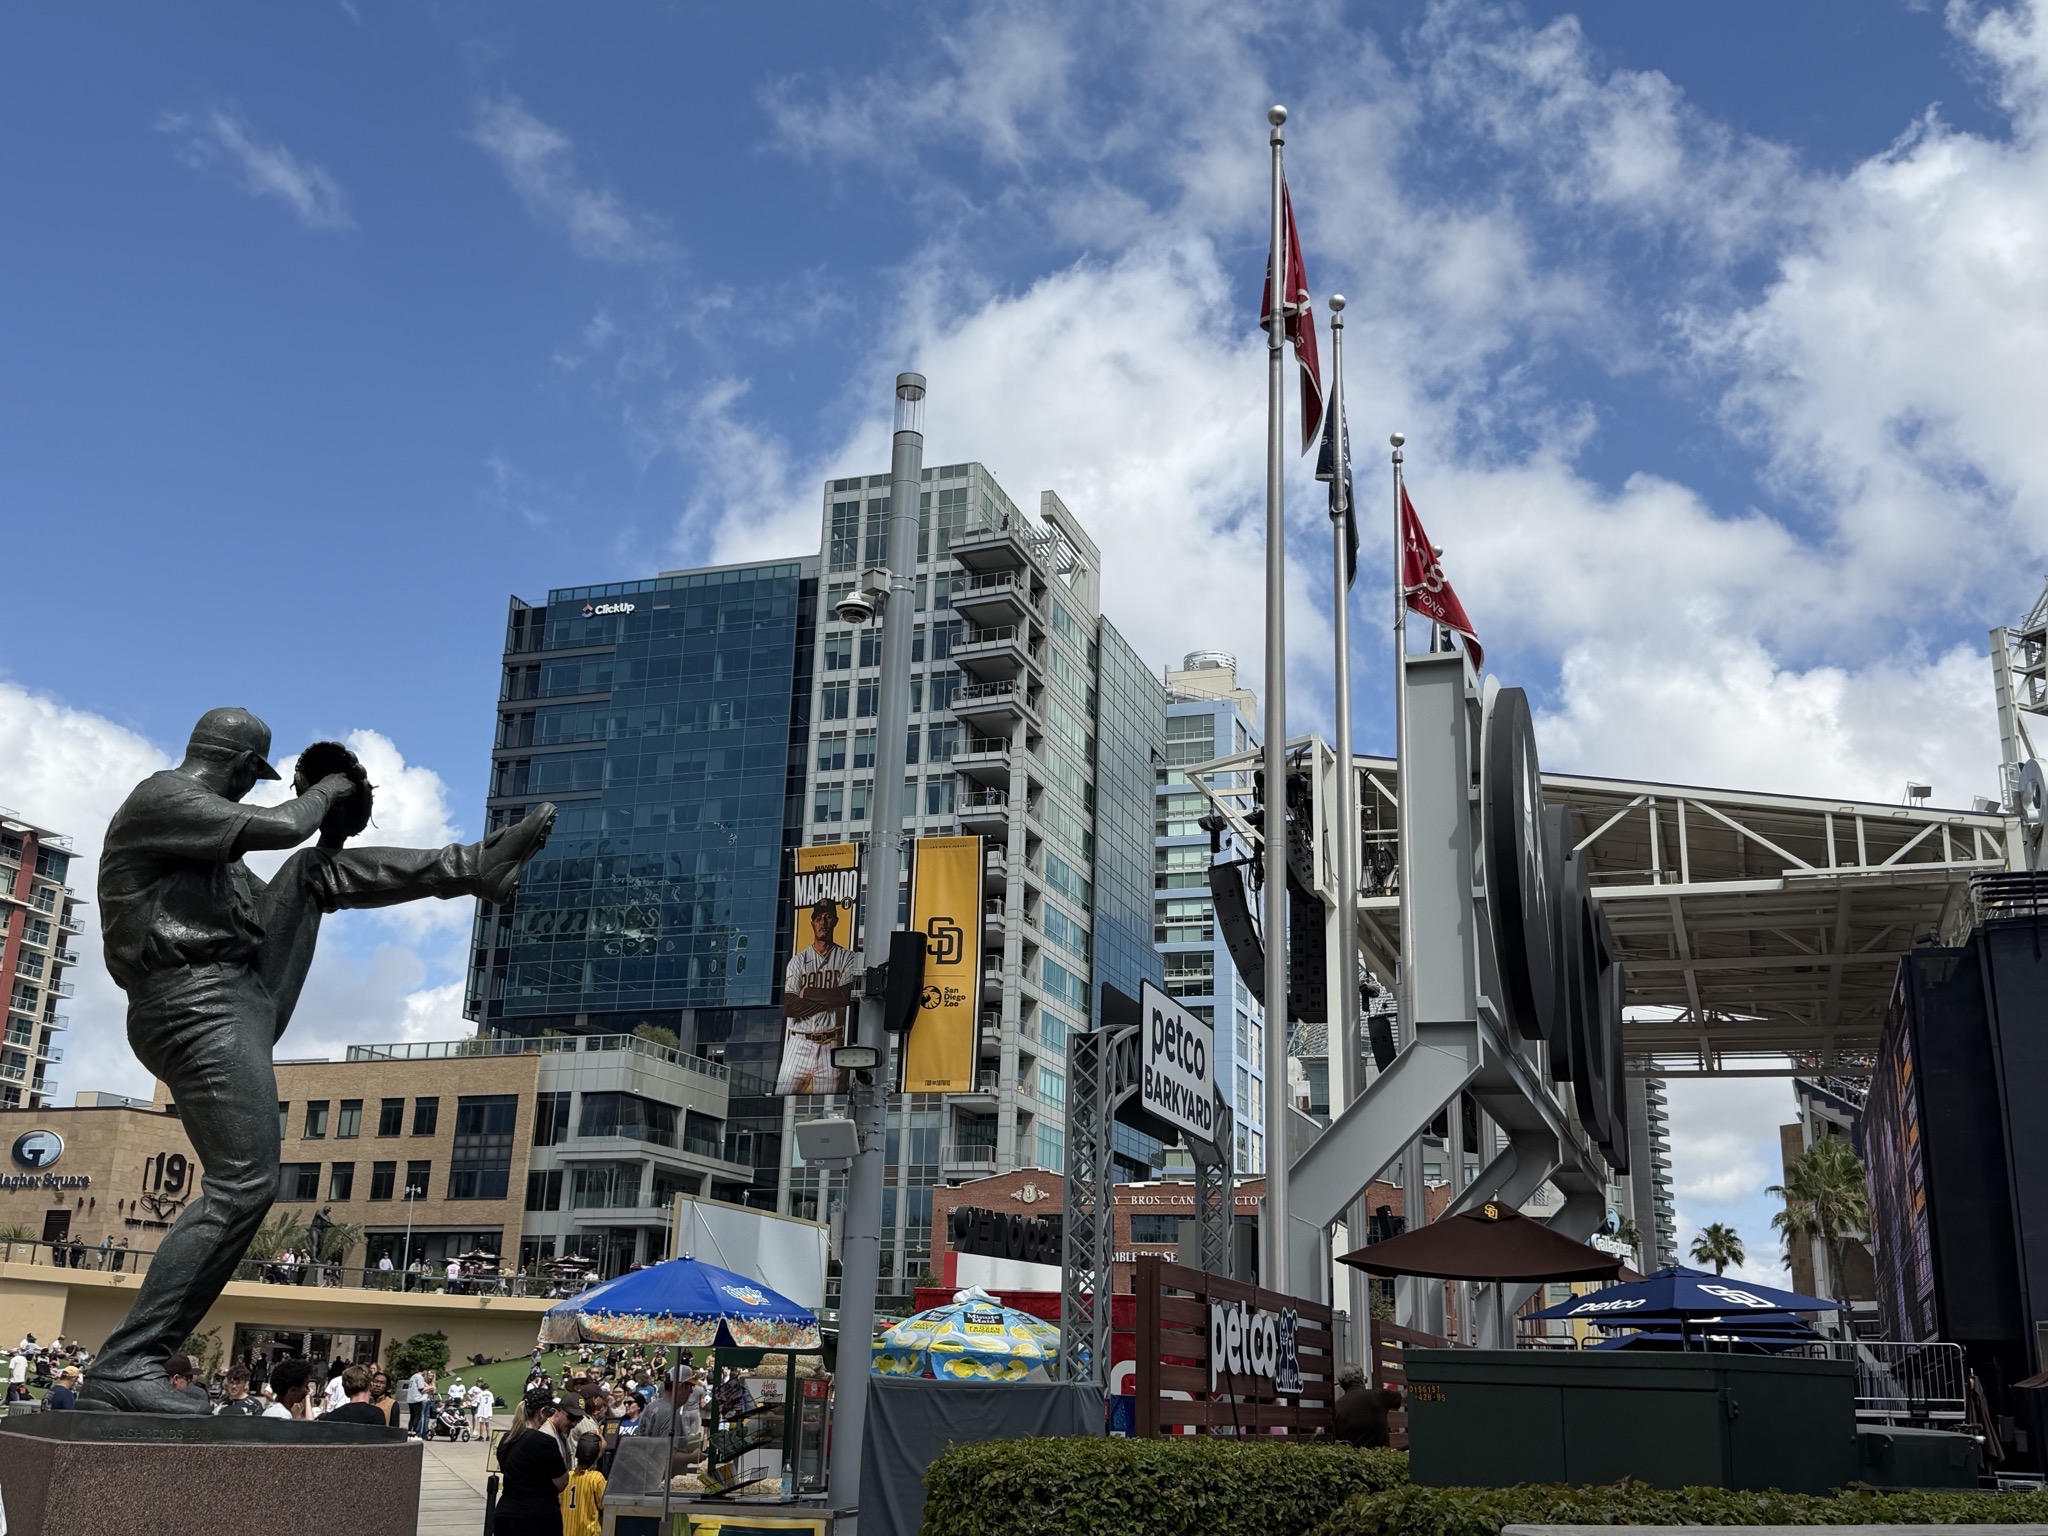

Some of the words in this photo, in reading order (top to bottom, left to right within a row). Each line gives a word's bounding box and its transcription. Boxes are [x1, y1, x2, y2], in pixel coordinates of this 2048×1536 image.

[594, 602, 635, 615] ClickUp
[795, 870, 858, 907] MACHADO
[927, 916, 963, 965] SD
[944, 993, 966, 1002] Diego
[1152, 1007, 1205, 1081] petco
[1144, 1063, 1212, 1131] BARKYARD
[0, 1172, 42, 1190] lagher
[43, 1172, 91, 1190] Square
[153, 1152, 187, 1193] 19
[1131, 1195, 1163, 1205] BROS.
[1171, 1195, 1194, 1205] CAN
[1484, 1203, 1498, 1219] SD
[1591, 1233, 1632, 1258] Gallagher
[1567, 1299, 1646, 1315] petco
[1210, 1300, 1278, 1392] petco
[118, 1428, 184, 1440] BEHRENDS
[569, 1485, 577, 1510] 1
